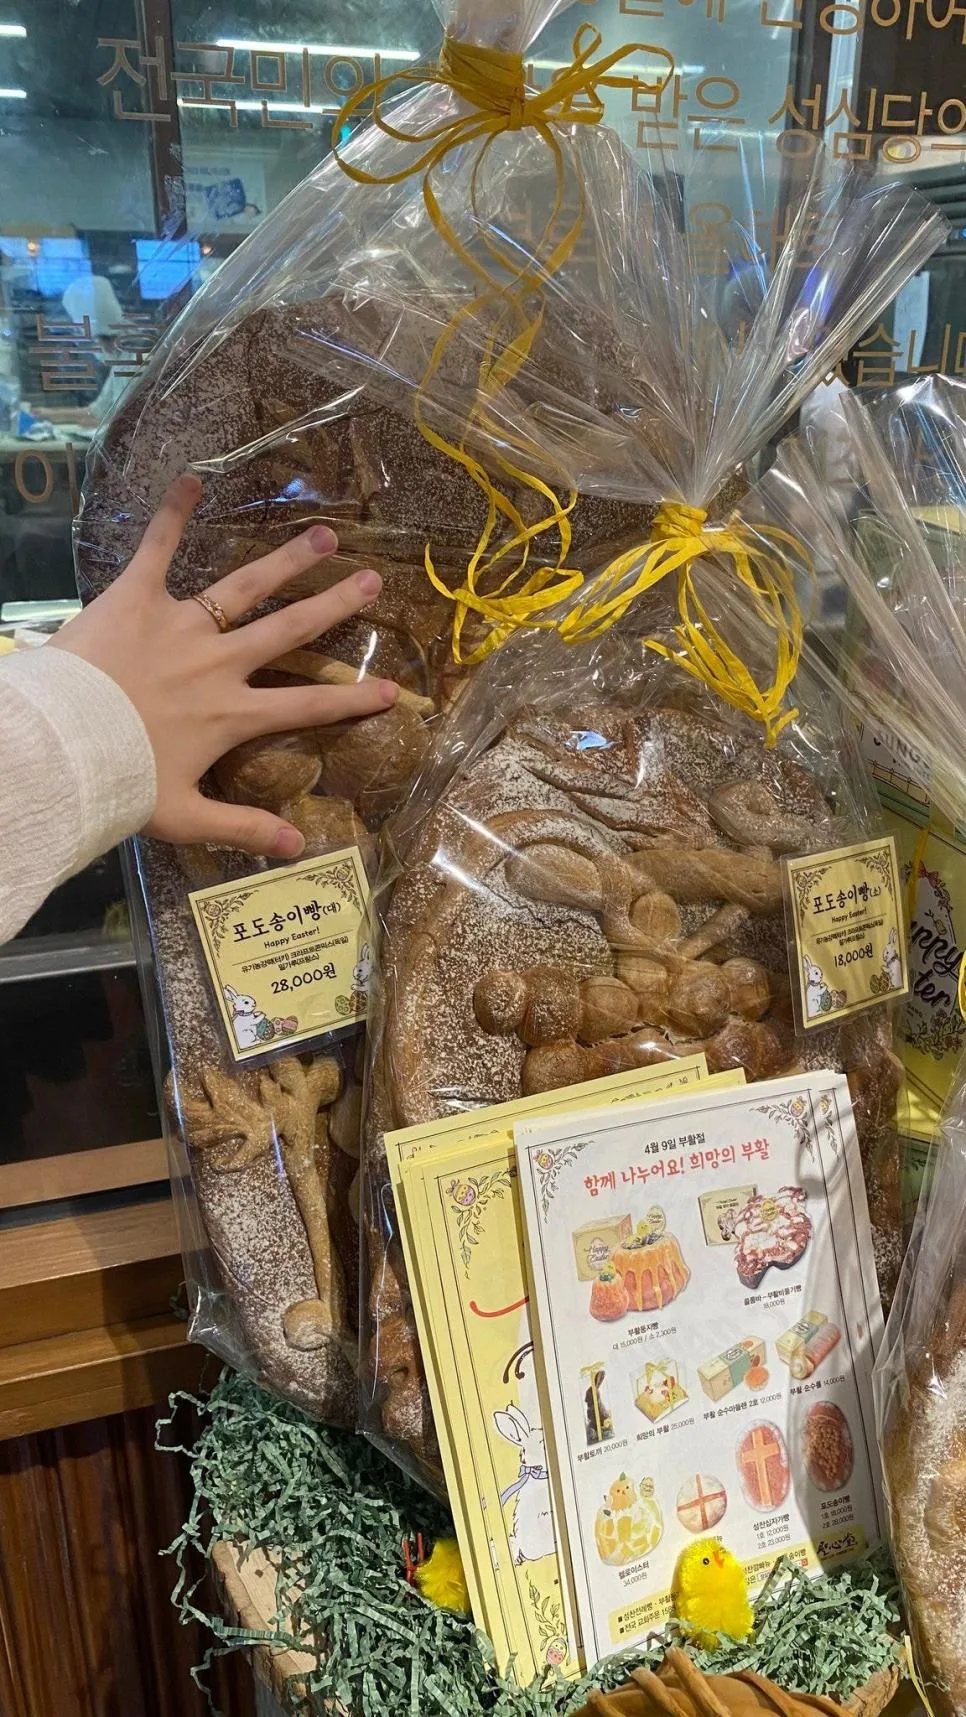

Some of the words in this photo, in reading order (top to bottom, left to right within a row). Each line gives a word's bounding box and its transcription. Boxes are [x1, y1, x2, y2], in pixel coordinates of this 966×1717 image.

[96, 36, 383, 129] 전국민의
[631, 74, 747, 153] 받은
[232, 899, 341, 943] 포도송이빵(대)
[263, 936, 290, 949] Happy
[291, 926, 321, 941] Easter!
[834, 942, 874, 968] 18,000원
[271, 962, 337, 995] 28,000원
[643, 1142, 660, 1155] 4월
[661, 1139, 677, 1151] 9일
[678, 1132, 706, 1147] 부활절
[583, 1170, 617, 1197] 함께
[621, 1157, 685, 1186] 나누어요!
[689, 1145, 736, 1171] 희망의
[741, 1138, 771, 1162] 부활
